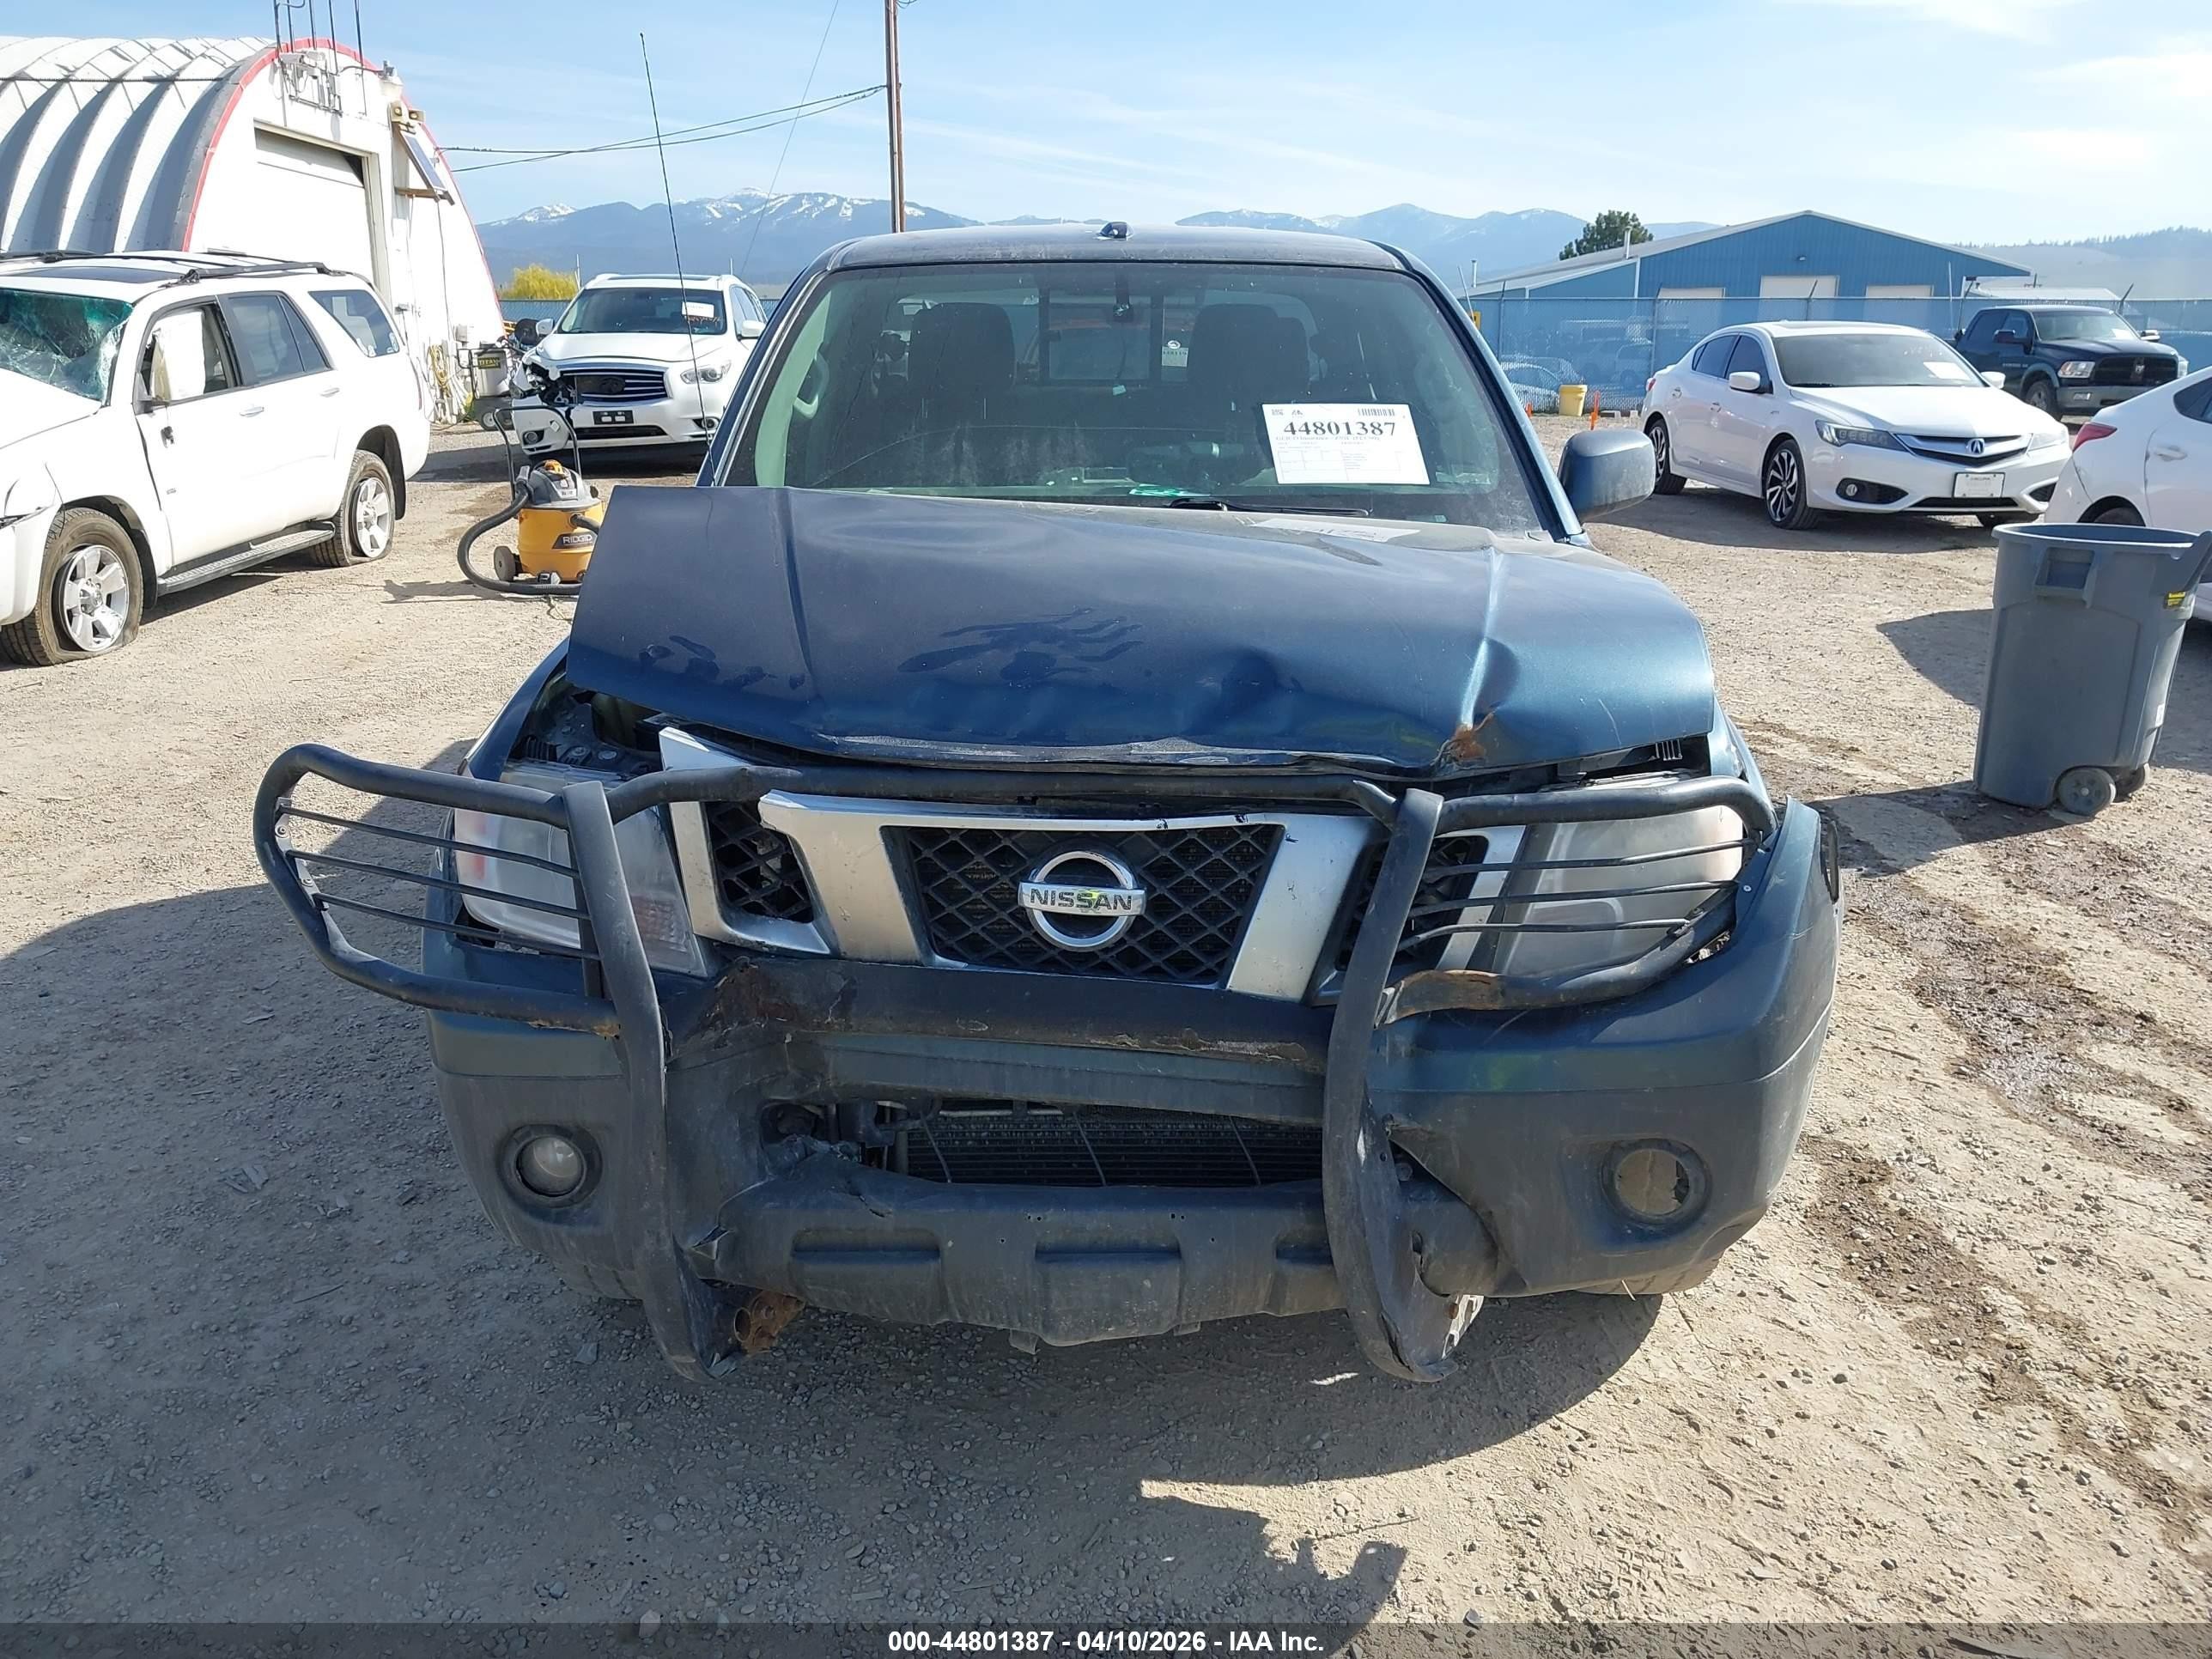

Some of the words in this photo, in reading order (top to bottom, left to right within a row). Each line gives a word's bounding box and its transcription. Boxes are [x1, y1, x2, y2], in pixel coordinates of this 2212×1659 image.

[1283, 421, 1396, 437] 44801387
[562, 534, 592, 544] RIDGID
[1030, 888, 1133, 911] NISSAN
